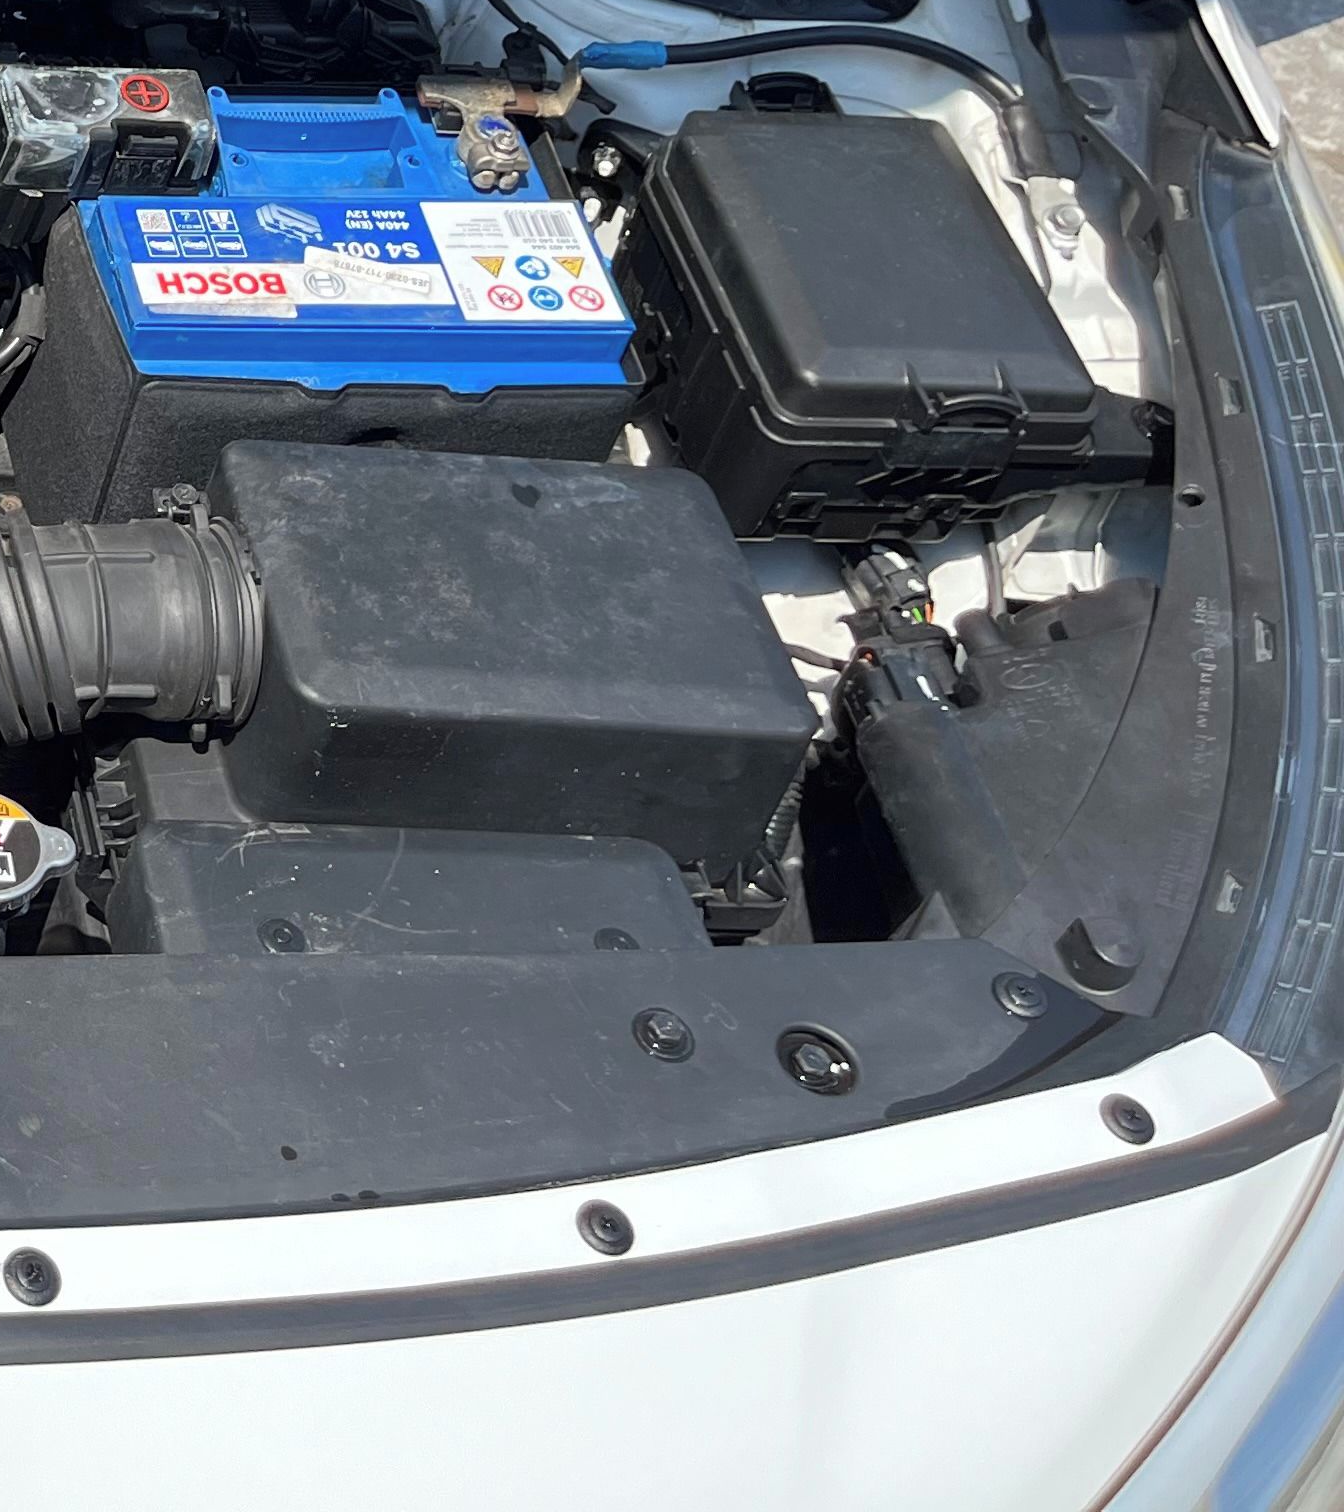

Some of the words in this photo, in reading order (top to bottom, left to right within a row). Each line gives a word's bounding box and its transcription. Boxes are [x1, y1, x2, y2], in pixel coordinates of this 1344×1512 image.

[346, 210, 369, 219] 12V
[345, 219, 373, 230] (EN)
[375, 221, 410, 230] 440A
[332, 241, 380, 259] 001
[385, 241, 420, 259] S4
[156, 272, 287, 295] BOSCH
